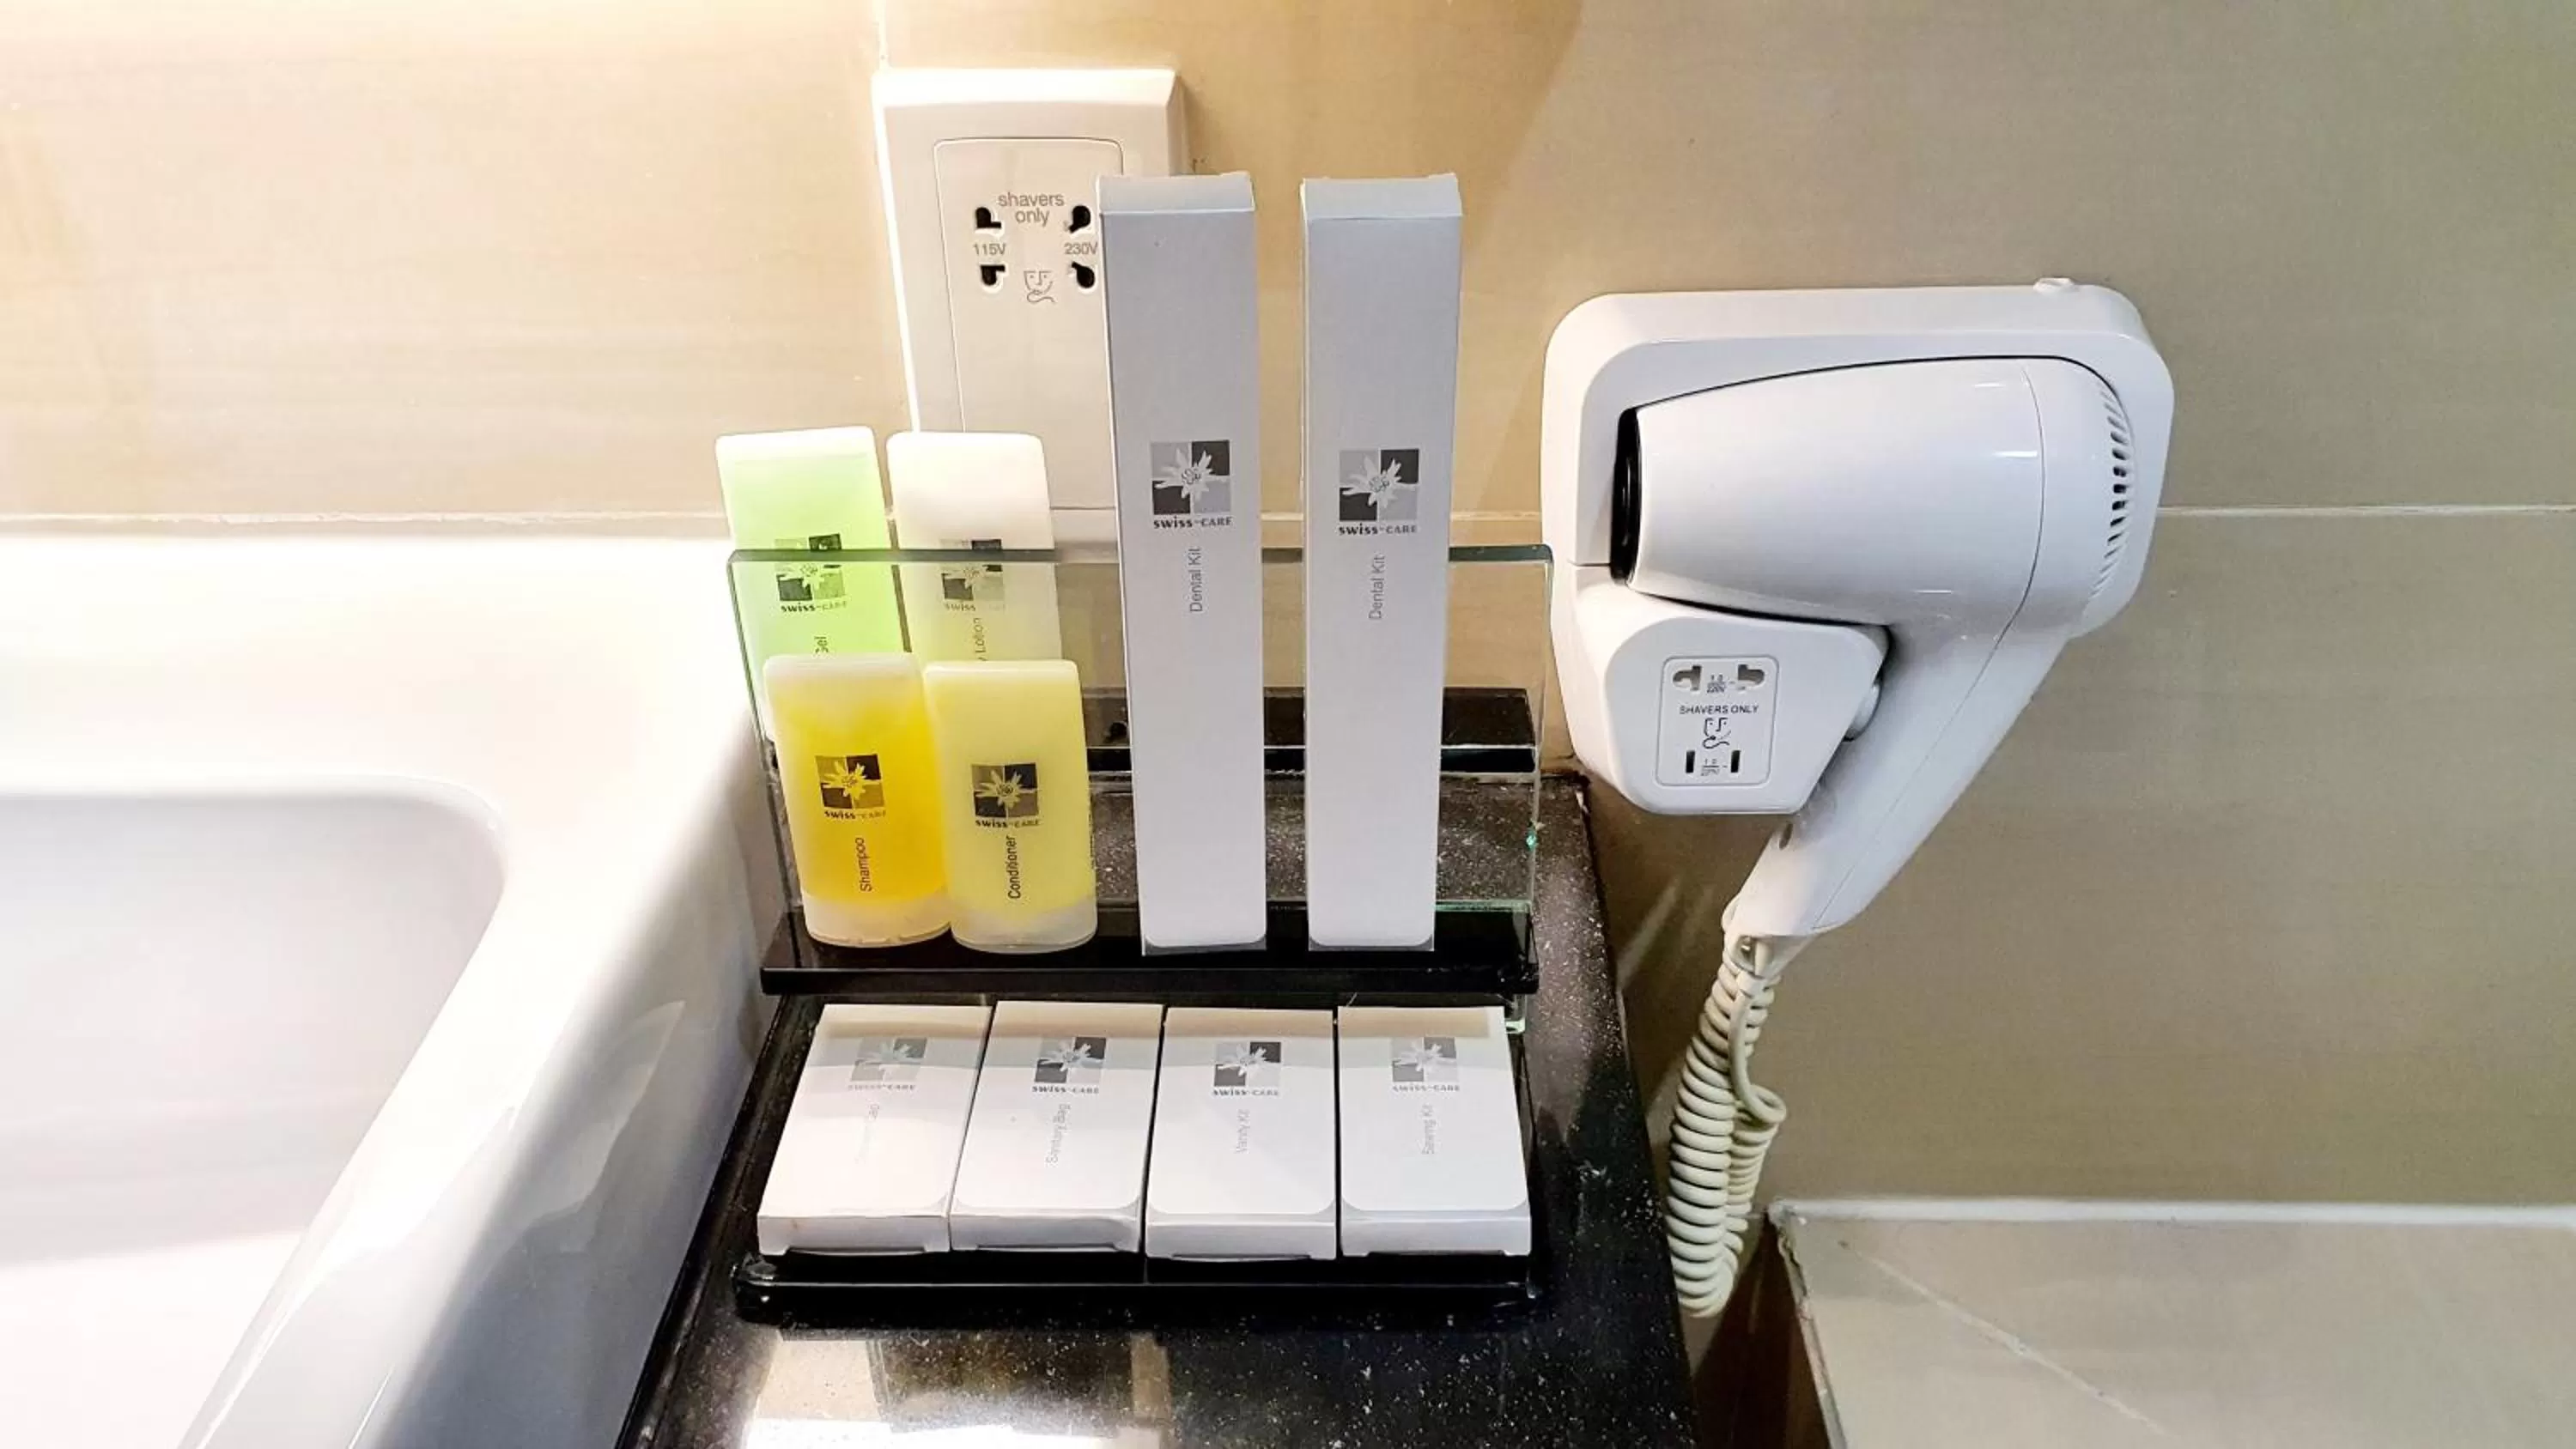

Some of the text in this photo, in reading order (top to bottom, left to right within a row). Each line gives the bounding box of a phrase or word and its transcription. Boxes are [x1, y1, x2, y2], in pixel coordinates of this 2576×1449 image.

[998, 191, 1065, 207] shavers
[1014, 207, 1051, 227] only
[973, 242, 1006, 256] 115V
[1063, 241, 1098, 255] 230V
[1187, 546, 1203, 613] Dental Kit
[1368, 554, 1386, 621] Dental Kit
[974, 617, 987, 654] Lotion
[1680, 705, 1759, 714] SHAVERS ONLY
[855, 837, 872, 892] Shampoo
[1005, 834, 1022, 900] Conditioner
